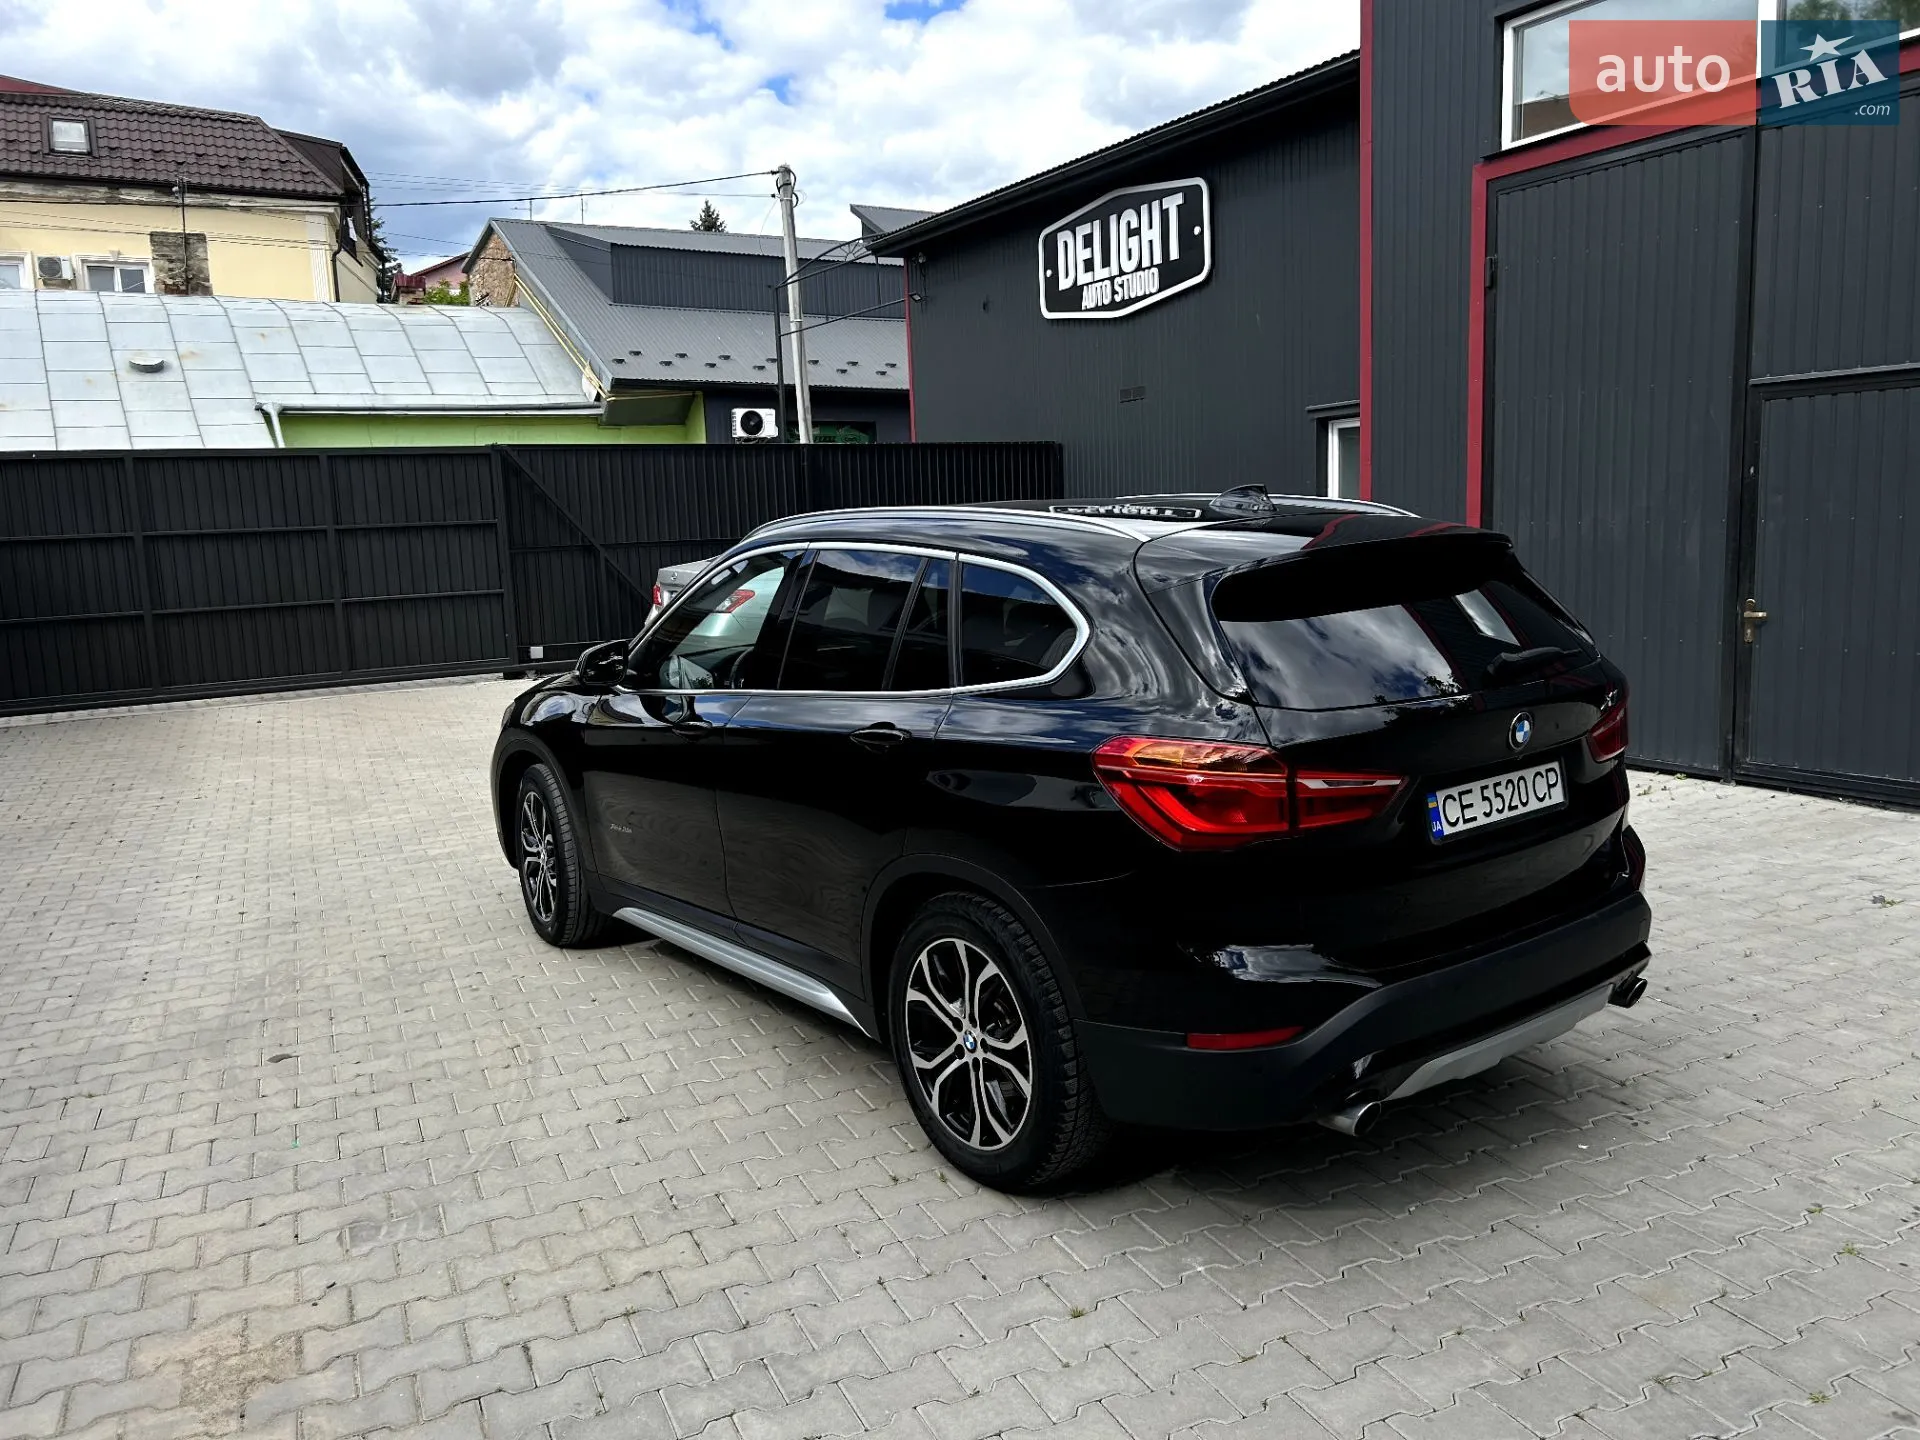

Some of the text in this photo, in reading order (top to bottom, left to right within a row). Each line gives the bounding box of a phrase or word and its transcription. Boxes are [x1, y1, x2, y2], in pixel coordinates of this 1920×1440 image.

[1057, 191, 1184, 291] DELIGHT
[1082, 267, 1160, 311] AUTO STUDIO
[1442, 767, 1559, 827] CE 5520 CP
